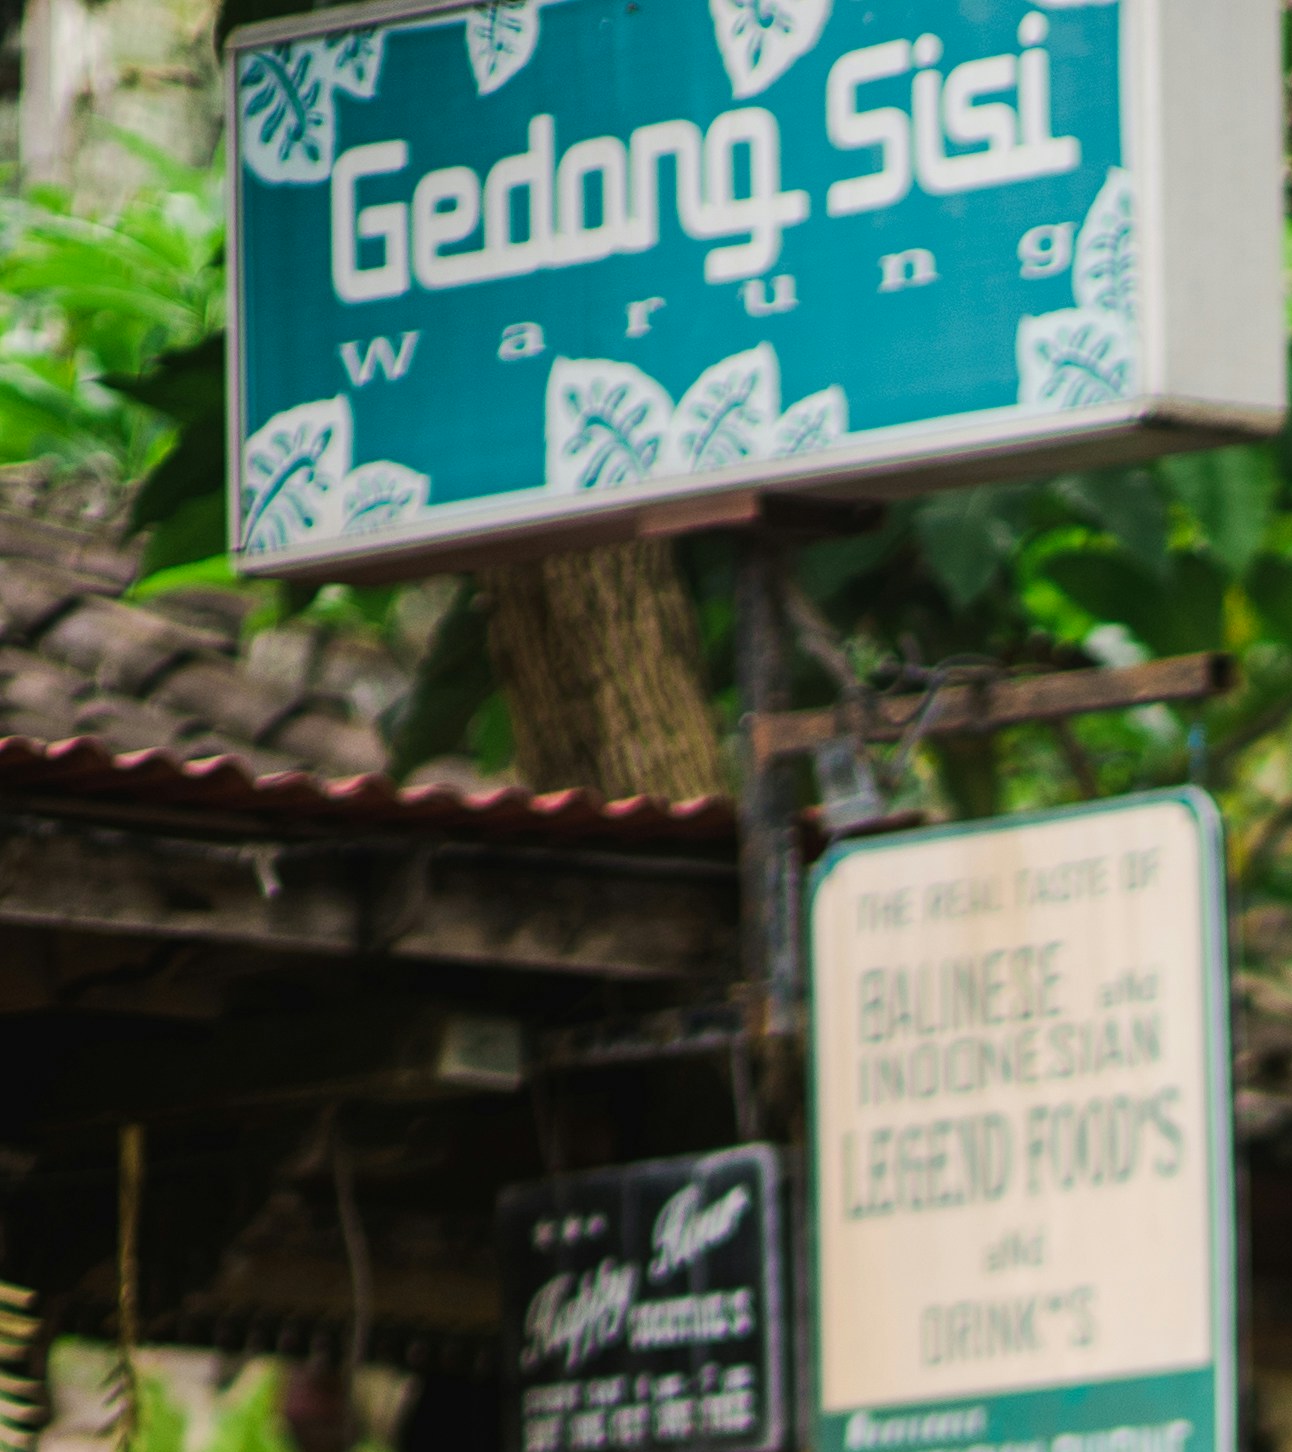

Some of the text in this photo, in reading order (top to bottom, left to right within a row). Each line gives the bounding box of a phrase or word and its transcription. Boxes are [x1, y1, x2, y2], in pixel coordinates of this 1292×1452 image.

[331, 11, 1081, 305] Gedong Sisi
[857, 886, 913, 932] THE
[858, 940, 1065, 1044] BALINESE
[857, 1012, 1162, 1107] INDONESIAN
[842, 1111, 1012, 1222] LEGEND
